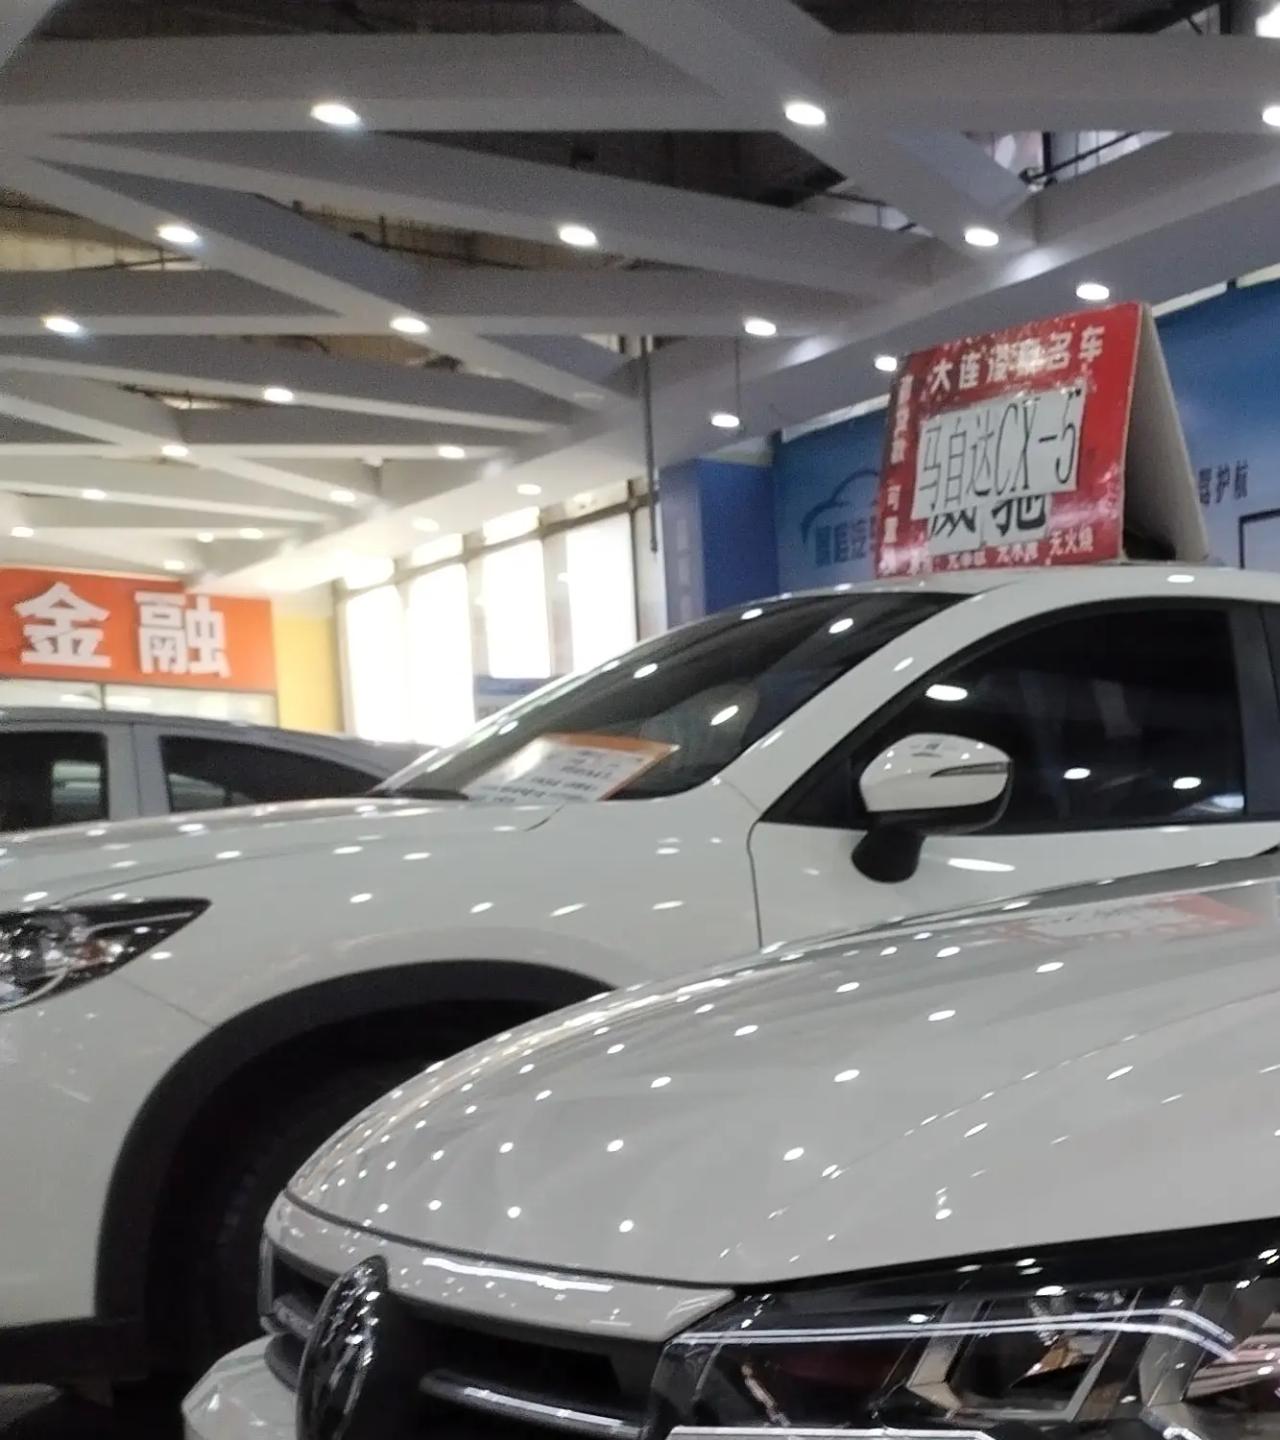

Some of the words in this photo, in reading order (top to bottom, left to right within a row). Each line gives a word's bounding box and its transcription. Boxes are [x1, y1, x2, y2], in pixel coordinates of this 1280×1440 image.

[917, 385, 1083, 509] 马自达CX-5
[14, 581, 232, 679] 金融
